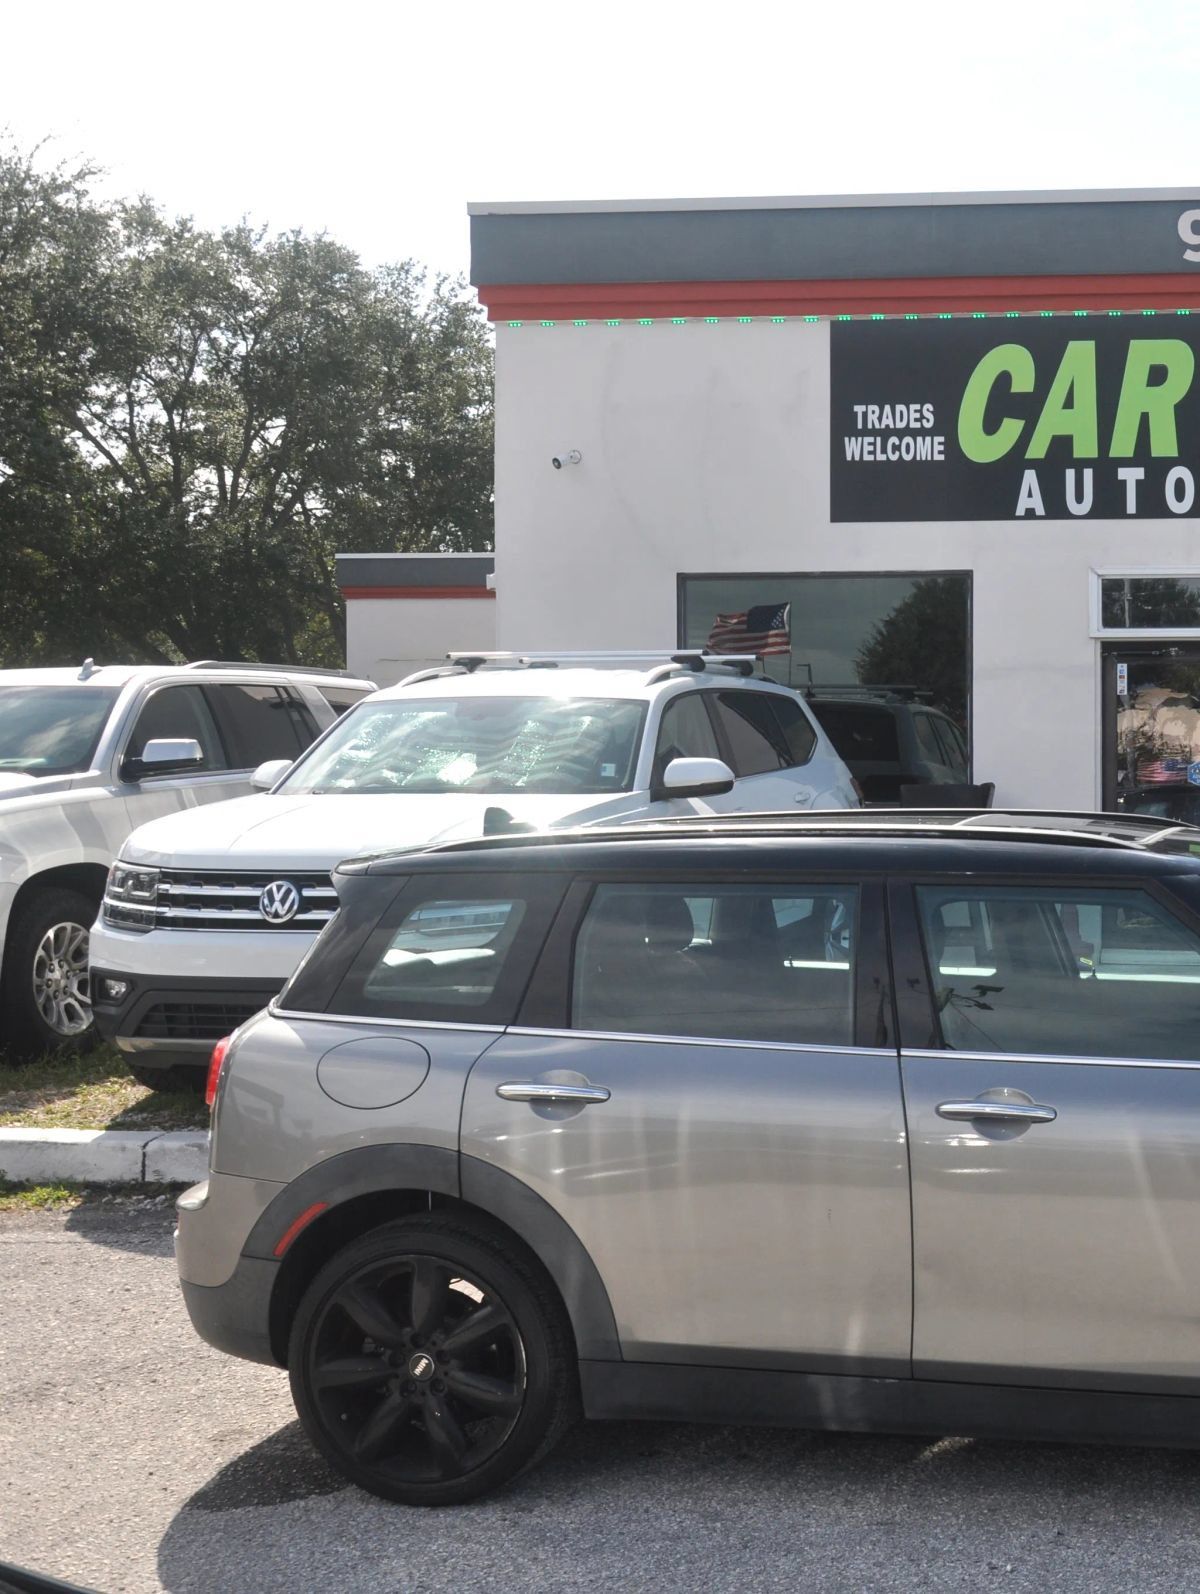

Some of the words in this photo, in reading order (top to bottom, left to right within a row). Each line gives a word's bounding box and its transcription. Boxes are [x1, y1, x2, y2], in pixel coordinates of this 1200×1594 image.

[853, 402, 935, 430] TRADES
[957, 340, 1196, 462] CAR
[843, 435, 946, 462] WELCOME
[1014, 465, 1196, 516] AUTO
[260, 881, 298, 922] VW
[413, 1357, 429, 1376] MINI
